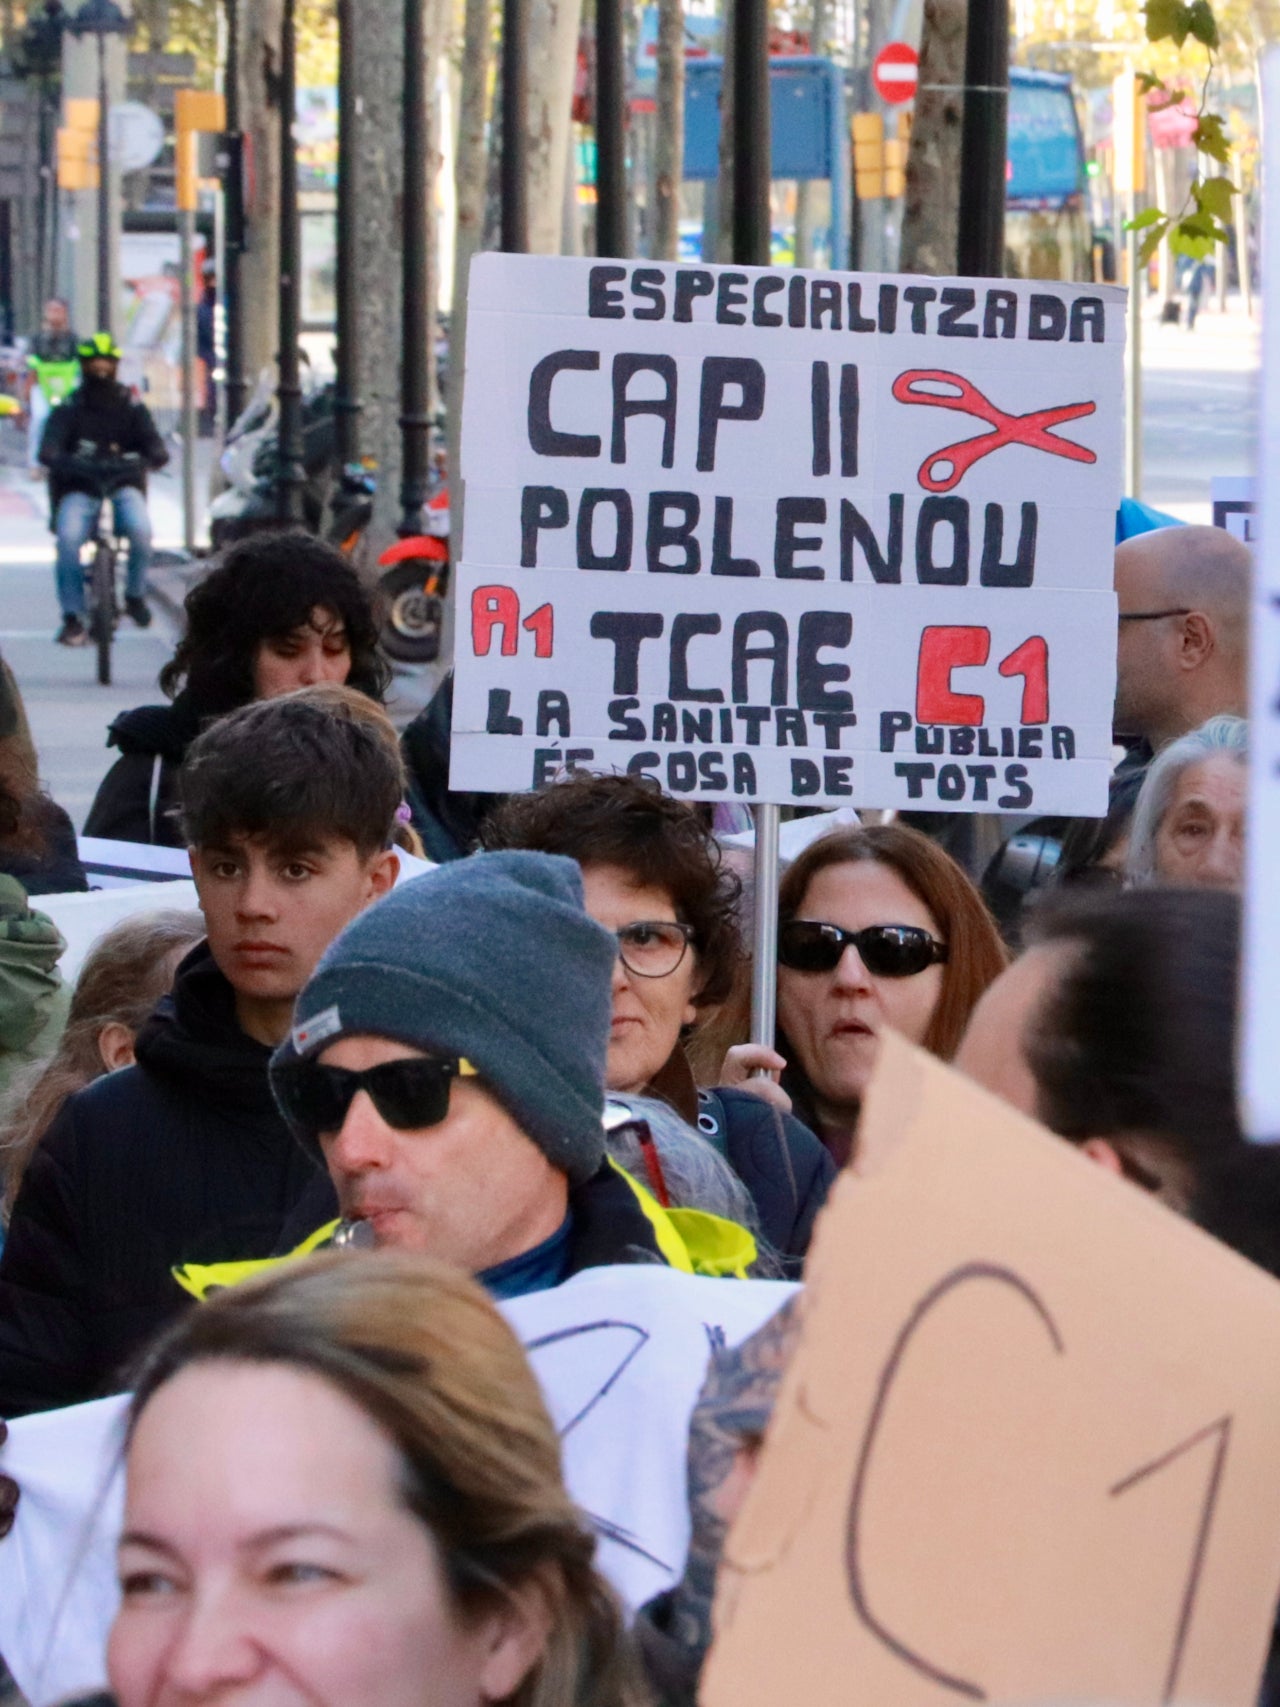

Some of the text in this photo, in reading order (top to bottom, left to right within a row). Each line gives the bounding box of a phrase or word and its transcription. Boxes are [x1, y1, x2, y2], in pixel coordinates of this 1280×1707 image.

[588, 265, 1105, 343] ESPECIALITZADA
[527, 348, 767, 473] CAP
[520, 485, 1039, 588] POBLENOU
[471, 584, 554, 658] A1
[590, 610, 853, 712] TCAE
[488, 688, 570, 738] LA
[608, 697, 858, 749] SANITAT
[915, 624, 1050, 727] C1
[626, 750, 758, 796] COSA
[790, 756, 854, 797] DE
[894, 761, 1034, 809] TOTS
